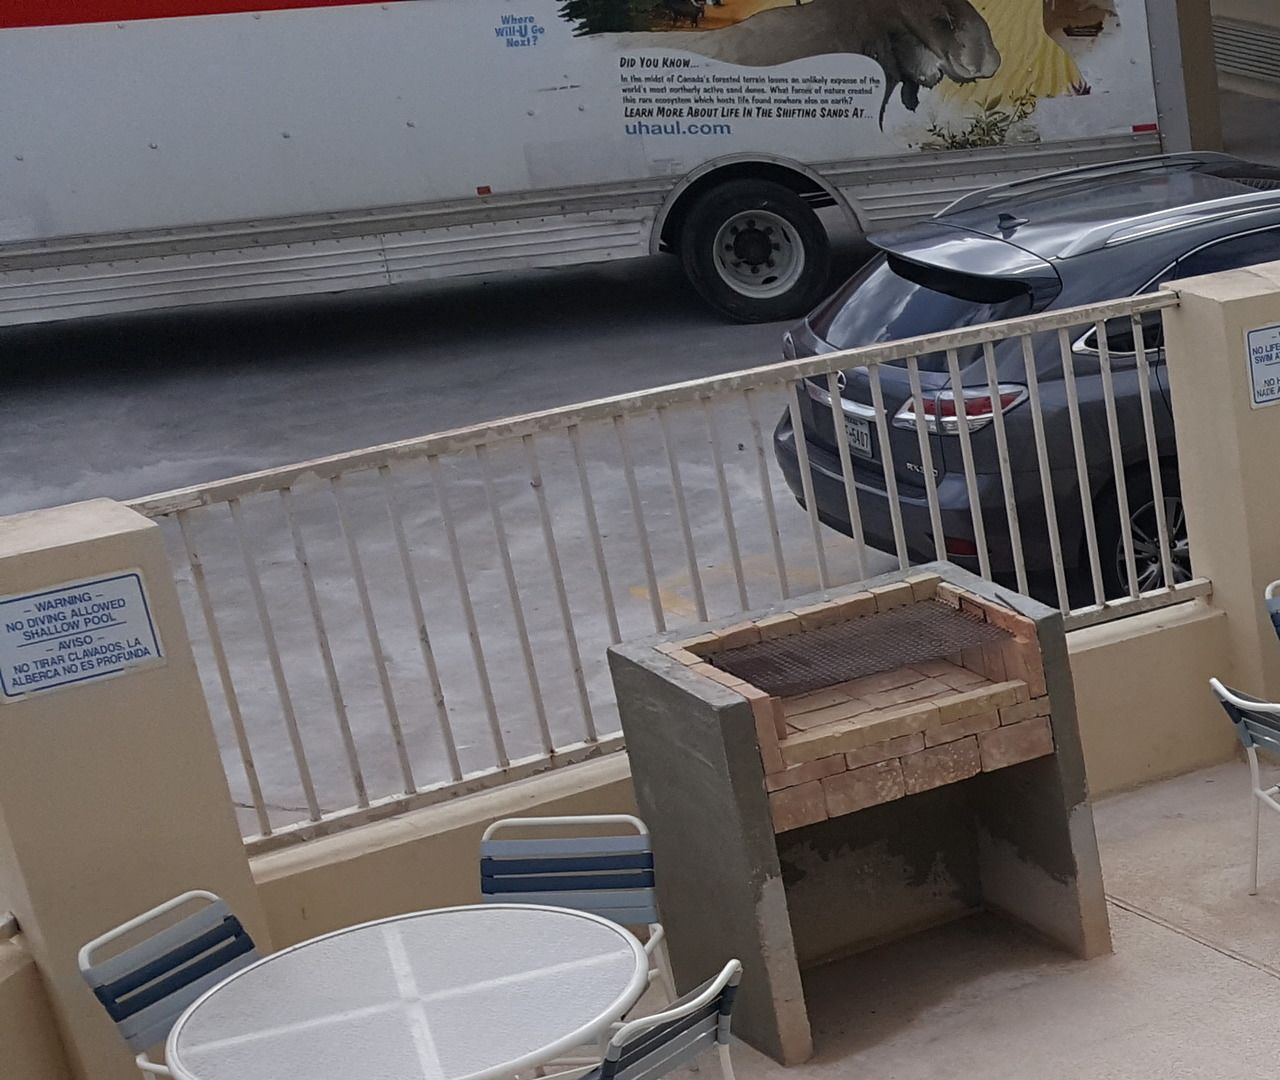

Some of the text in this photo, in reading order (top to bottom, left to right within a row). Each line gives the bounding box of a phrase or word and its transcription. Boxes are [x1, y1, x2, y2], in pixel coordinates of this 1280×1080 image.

[501, 14, 534, 25] Where
[531, 25, 544, 34] Go
[620, 57, 636, 68] DID
[640, 57, 659, 68] YOU
[677, 75, 710, 83] Canada's
[624, 107, 654, 118] LEARN
[657, 107, 684, 118] MORE
[686, 107, 719, 118] ABOUT
[721, 107, 739, 118] LIFE
[743, 107, 752, 118] IN
[756, 107, 773, 118] THE
[776, 107, 817, 118] SHIFTING
[820, 107, 848, 118] SANDS
[626, 121, 731, 135] uhaul.com
[1252, 346, 1264, 356] NO
[1254, 353, 1273, 364] SWIM
[1264, 377, 1276, 388] NO
[35, 592, 92, 612] WARNING
[6, 598, 126, 633] NO DIVING ALLOWED
[22, 612, 116, 641] SHALLOW POOL
[58, 635, 93, 651] AVISO
[13, 663, 30, 675] NO
[33, 655, 65, 669] TIRAR
[127, 637, 142, 650] LA
[12, 646, 151, 688] ALBERCA NO ES PROFUNDA
